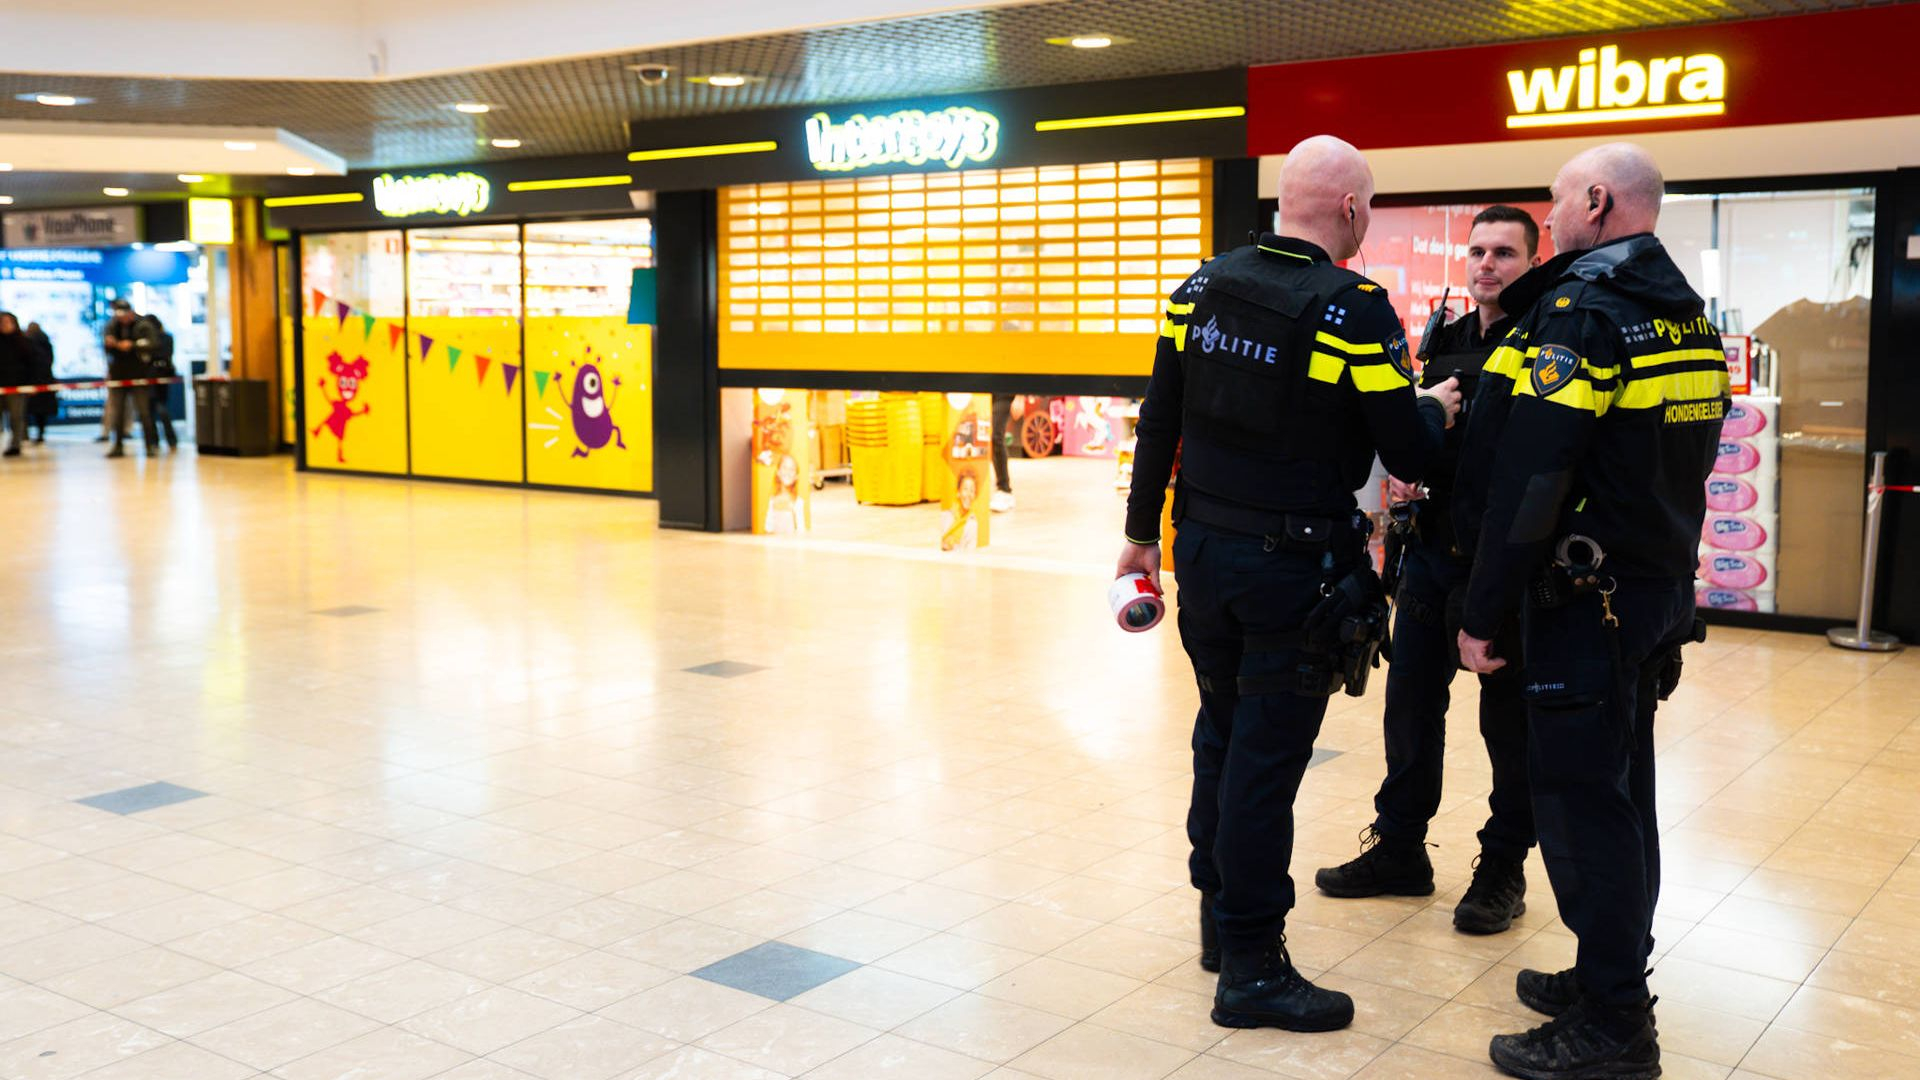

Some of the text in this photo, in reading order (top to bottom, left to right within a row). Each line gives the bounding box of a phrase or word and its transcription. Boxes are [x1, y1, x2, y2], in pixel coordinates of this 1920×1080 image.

[1506, 44, 1726, 113] wibra
[1192, 319, 1278, 364] POLITIE
[1540, 348, 1574, 365] POLITIE
